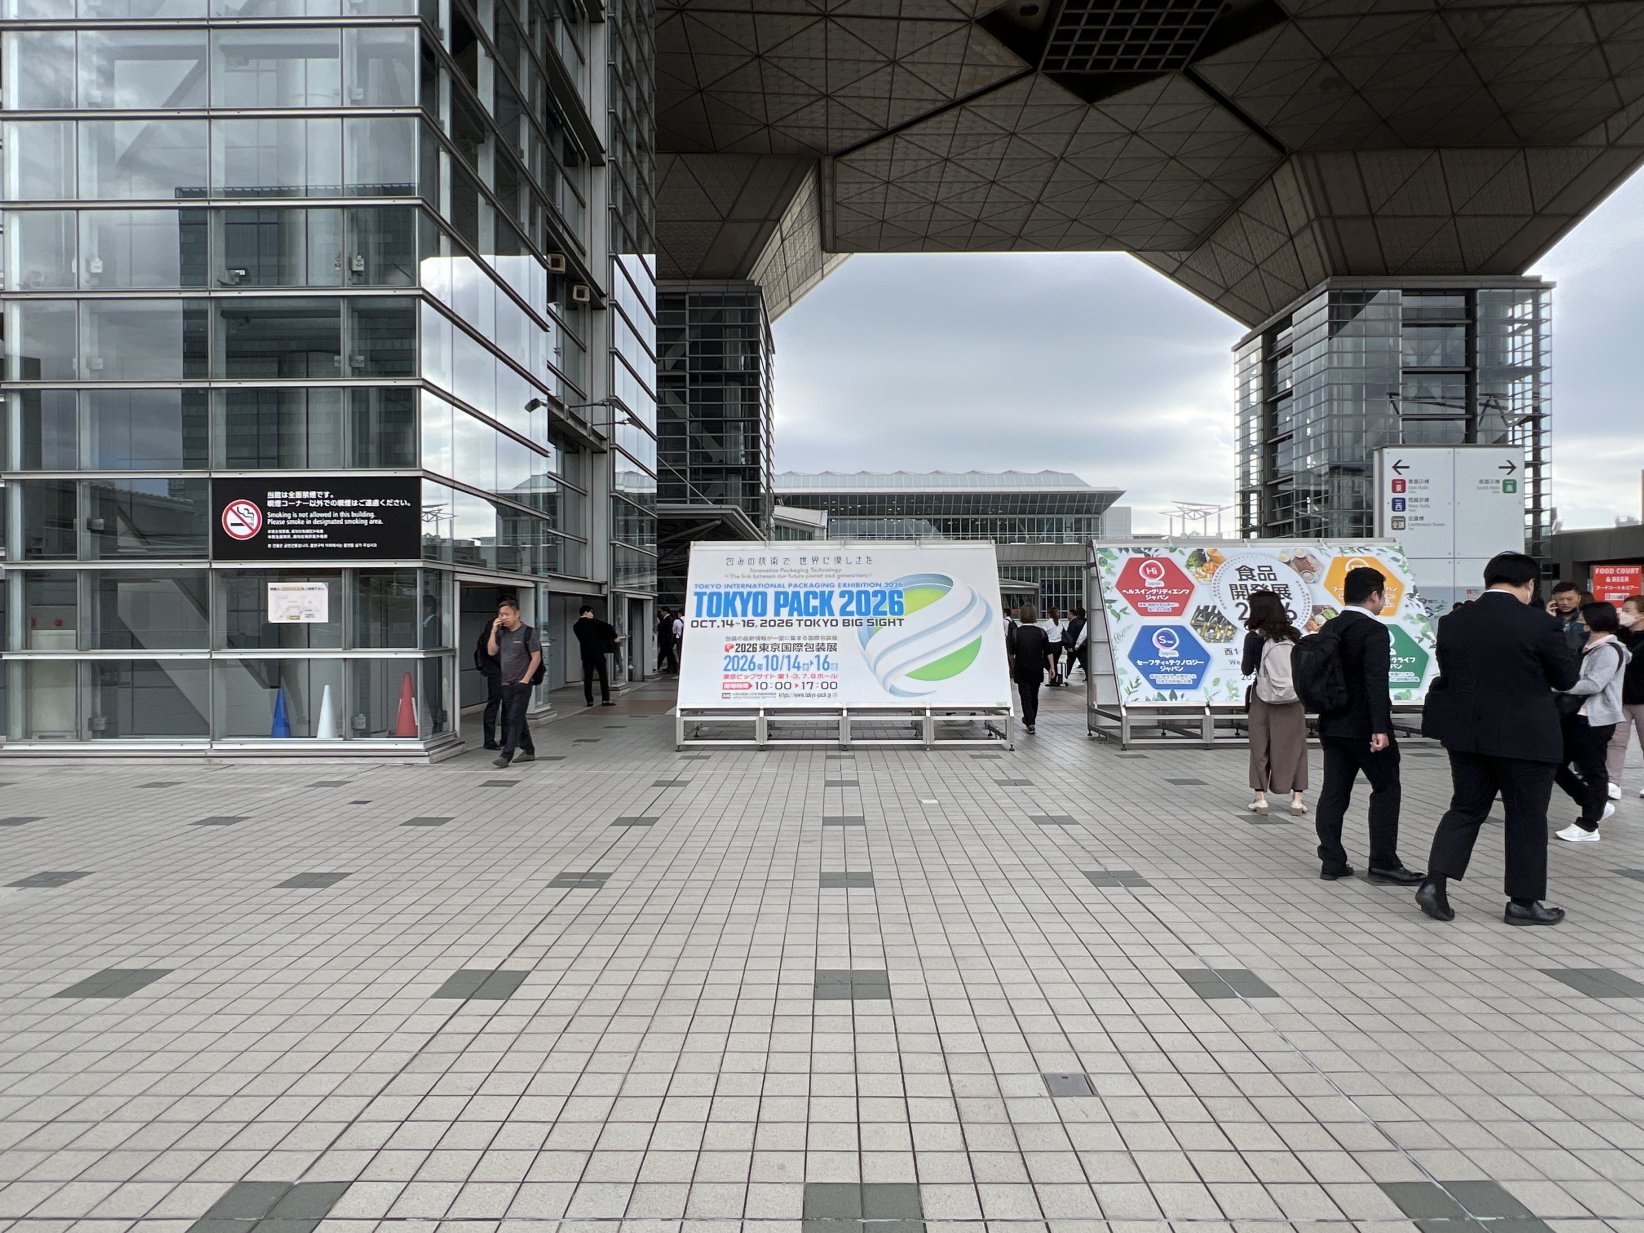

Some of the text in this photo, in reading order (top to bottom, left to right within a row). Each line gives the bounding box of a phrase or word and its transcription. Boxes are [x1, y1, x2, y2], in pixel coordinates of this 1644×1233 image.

[267, 511, 291, 519] Smoking
[351, 511, 375, 519] building.
[1146, 567, 1158, 575] Hi
[1235, 564, 1278, 581] 食品
[694, 589, 905, 618] TOKYO PACK 2026
[1235, 601, 1297, 621] 26
[759, 619, 794, 628] 2026
[796, 619, 839, 628] TOKYO
[842, 618, 864, 627] BIG
[866, 618, 905, 627] SIGHT
